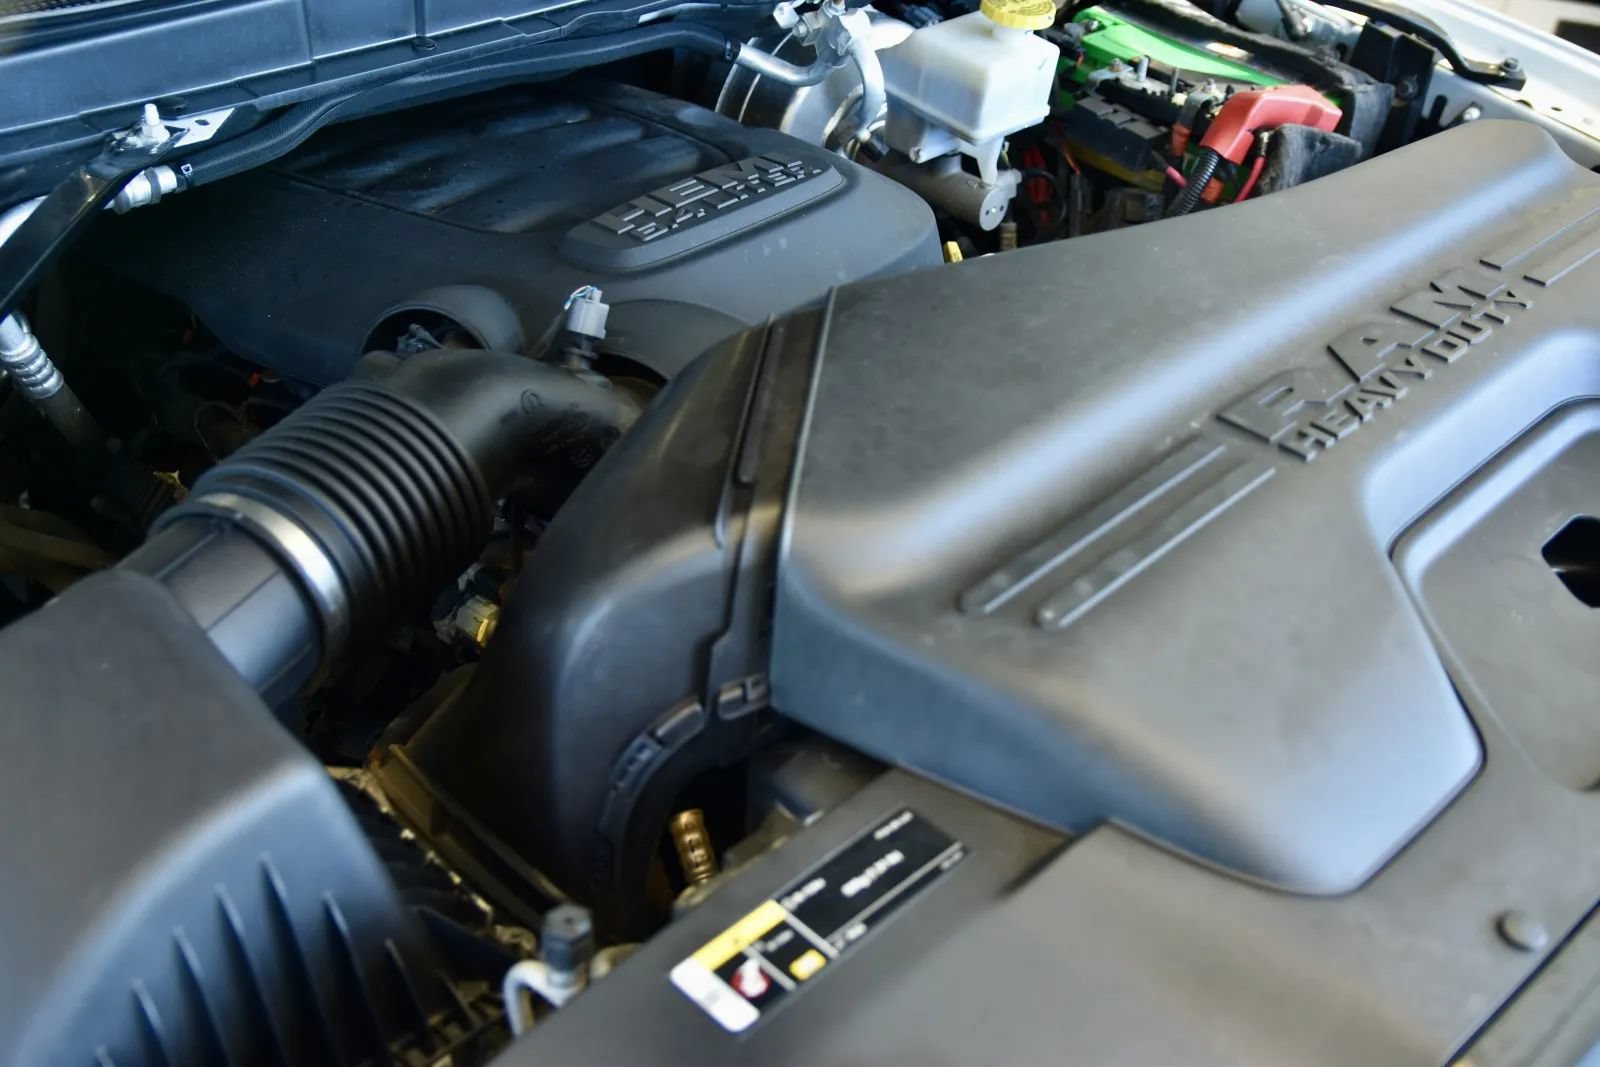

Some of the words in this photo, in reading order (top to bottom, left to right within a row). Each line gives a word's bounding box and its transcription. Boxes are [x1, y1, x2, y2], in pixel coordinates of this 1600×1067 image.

[592, 152, 803, 235] HEMI
[1216, 267, 1506, 444] RAM
[1278, 355, 1433, 463] HEAVY
[1421, 288, 1534, 364] DUTY
